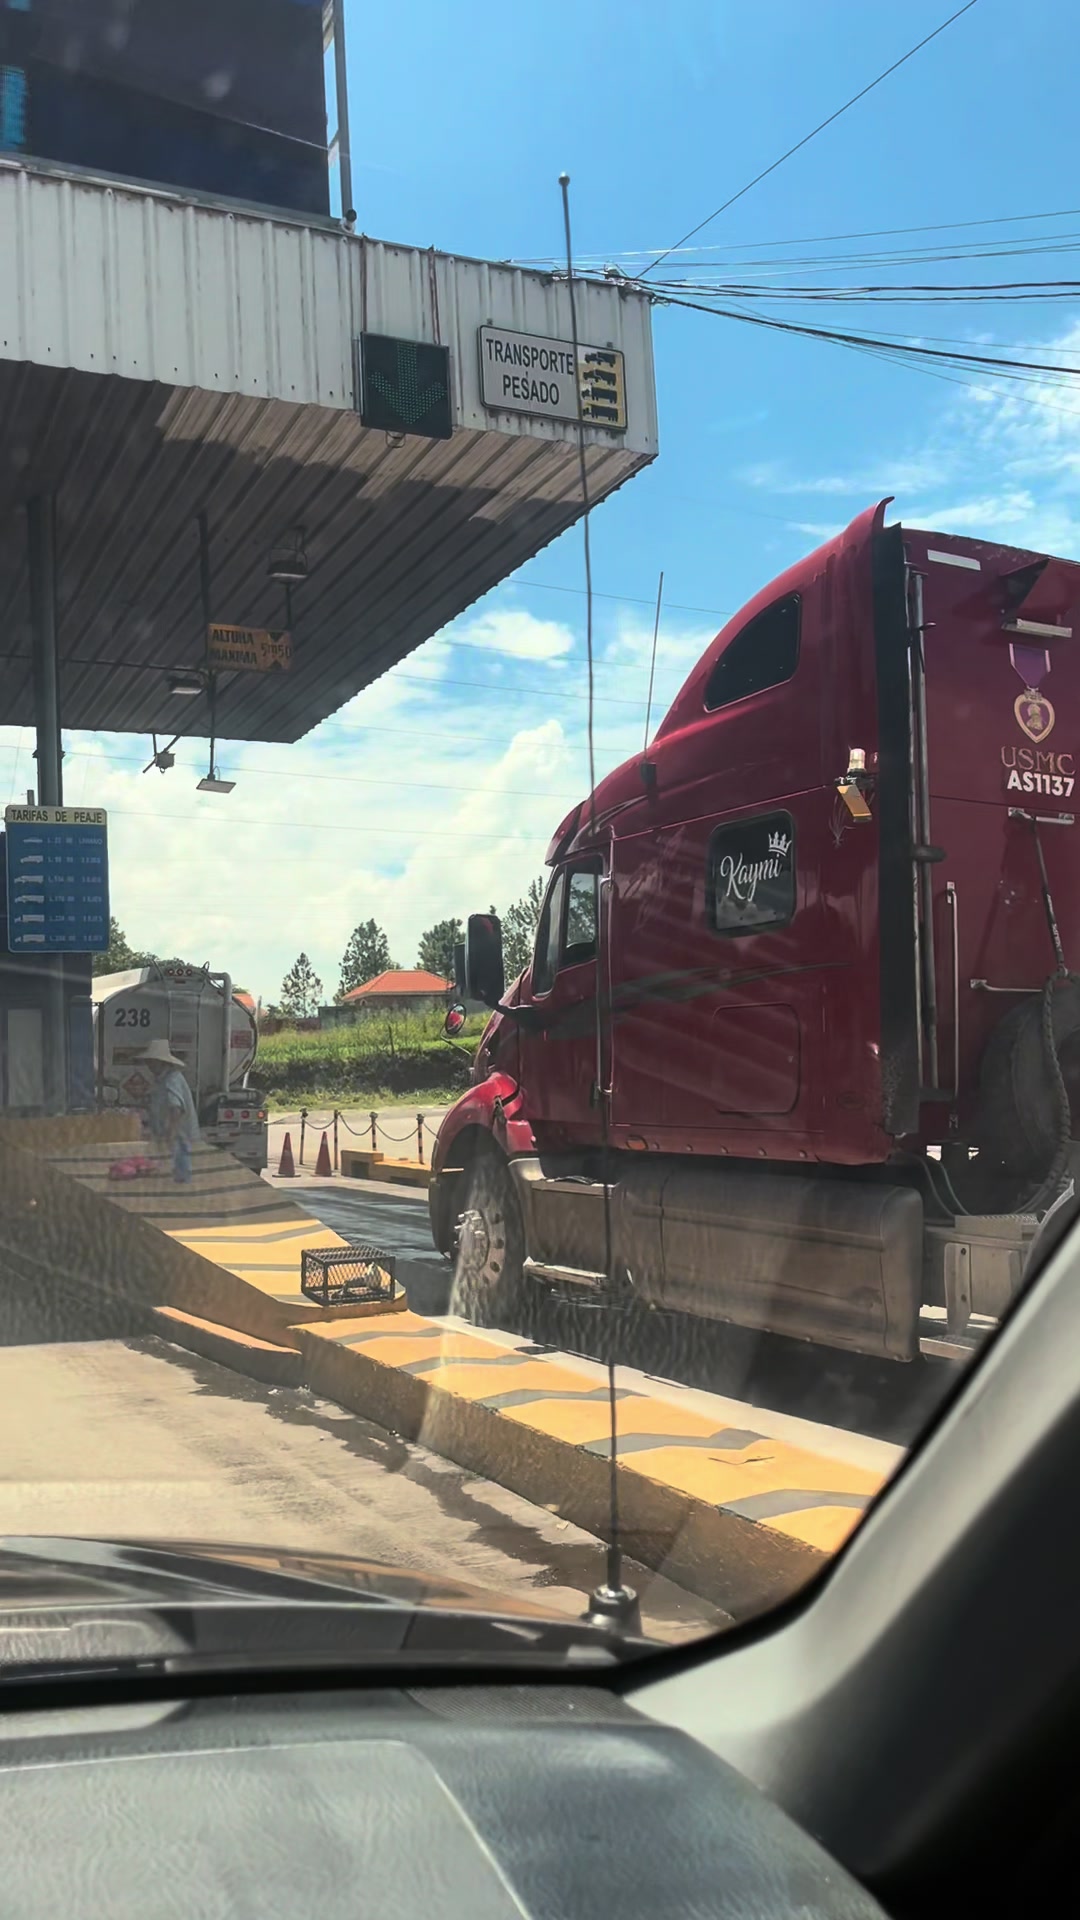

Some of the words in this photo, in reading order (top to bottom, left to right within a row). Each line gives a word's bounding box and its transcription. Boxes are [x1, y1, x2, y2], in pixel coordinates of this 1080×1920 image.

[486, 338, 575, 376] TRANSPORTE
[502, 374, 560, 405] PESADO
[212, 629, 254, 645] ALTURA
[1001, 746, 1076, 776] USMC
[1007, 769, 1075, 797] AS1137
[11, 809, 48, 822] TARIFAS
[55, 811, 67, 822] DE
[74, 812, 102, 823] PEAJE
[720, 852, 783, 902] Kaymi
[114, 1008, 151, 1028] 238
